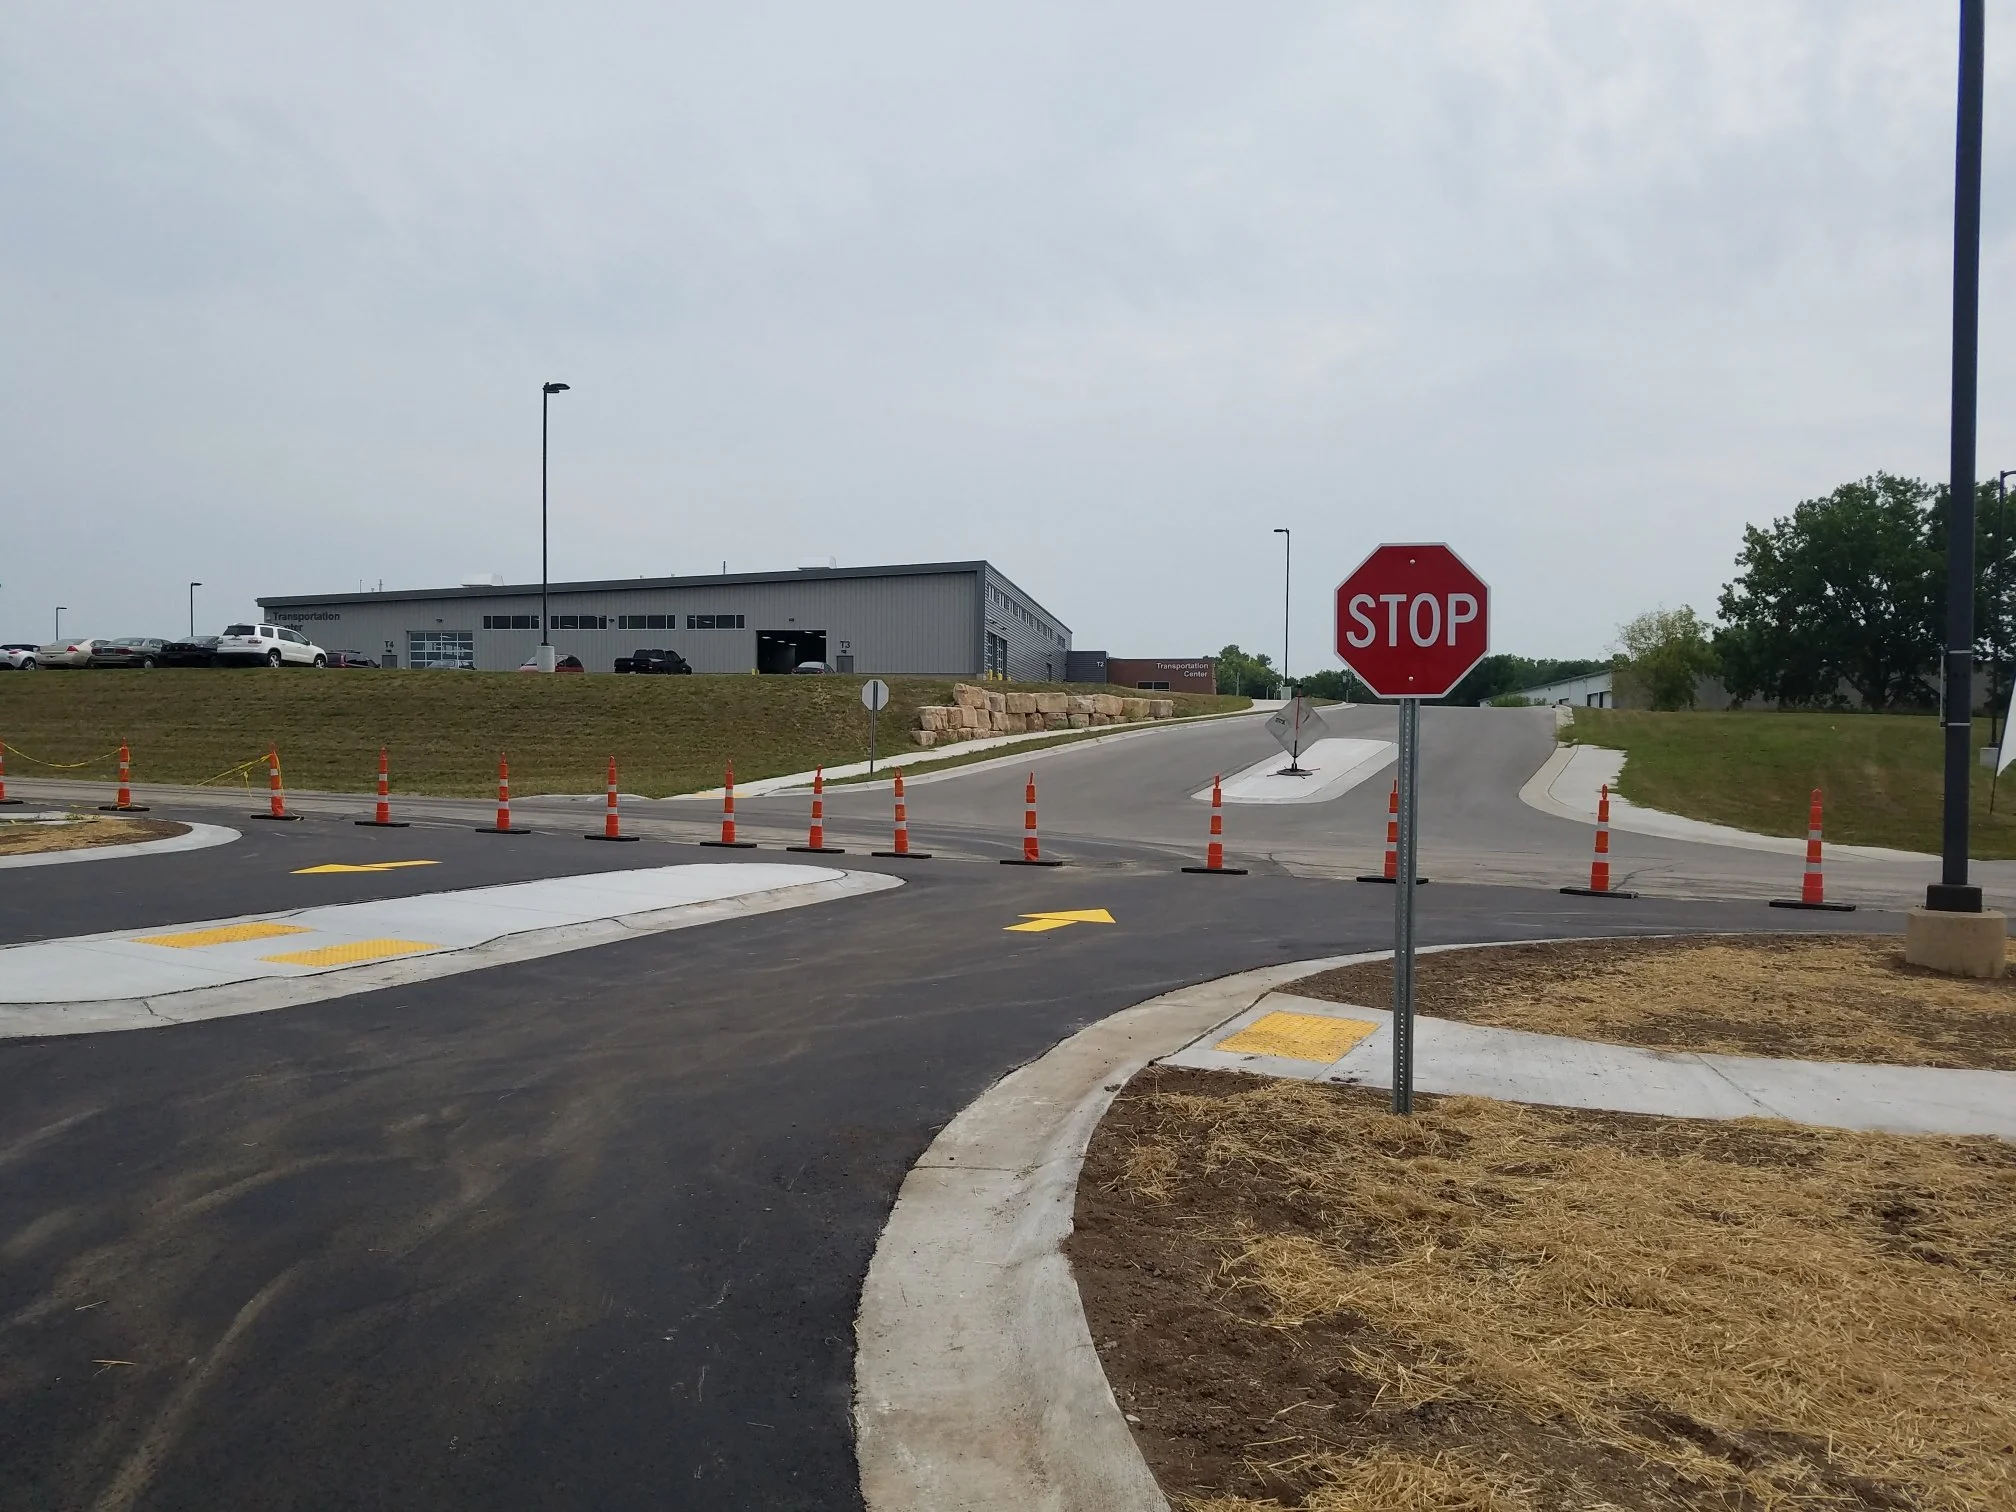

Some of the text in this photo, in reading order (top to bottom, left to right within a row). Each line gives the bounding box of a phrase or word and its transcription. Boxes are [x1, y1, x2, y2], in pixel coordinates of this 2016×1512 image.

[273, 611, 341, 622] Transportation
[1346, 592, 1479, 648] STOP
[384, 640, 394, 648] T4
[840, 640, 851, 649] T3
[1156, 662, 1209, 671] Transportation
[1183, 670, 1208, 678] Center
